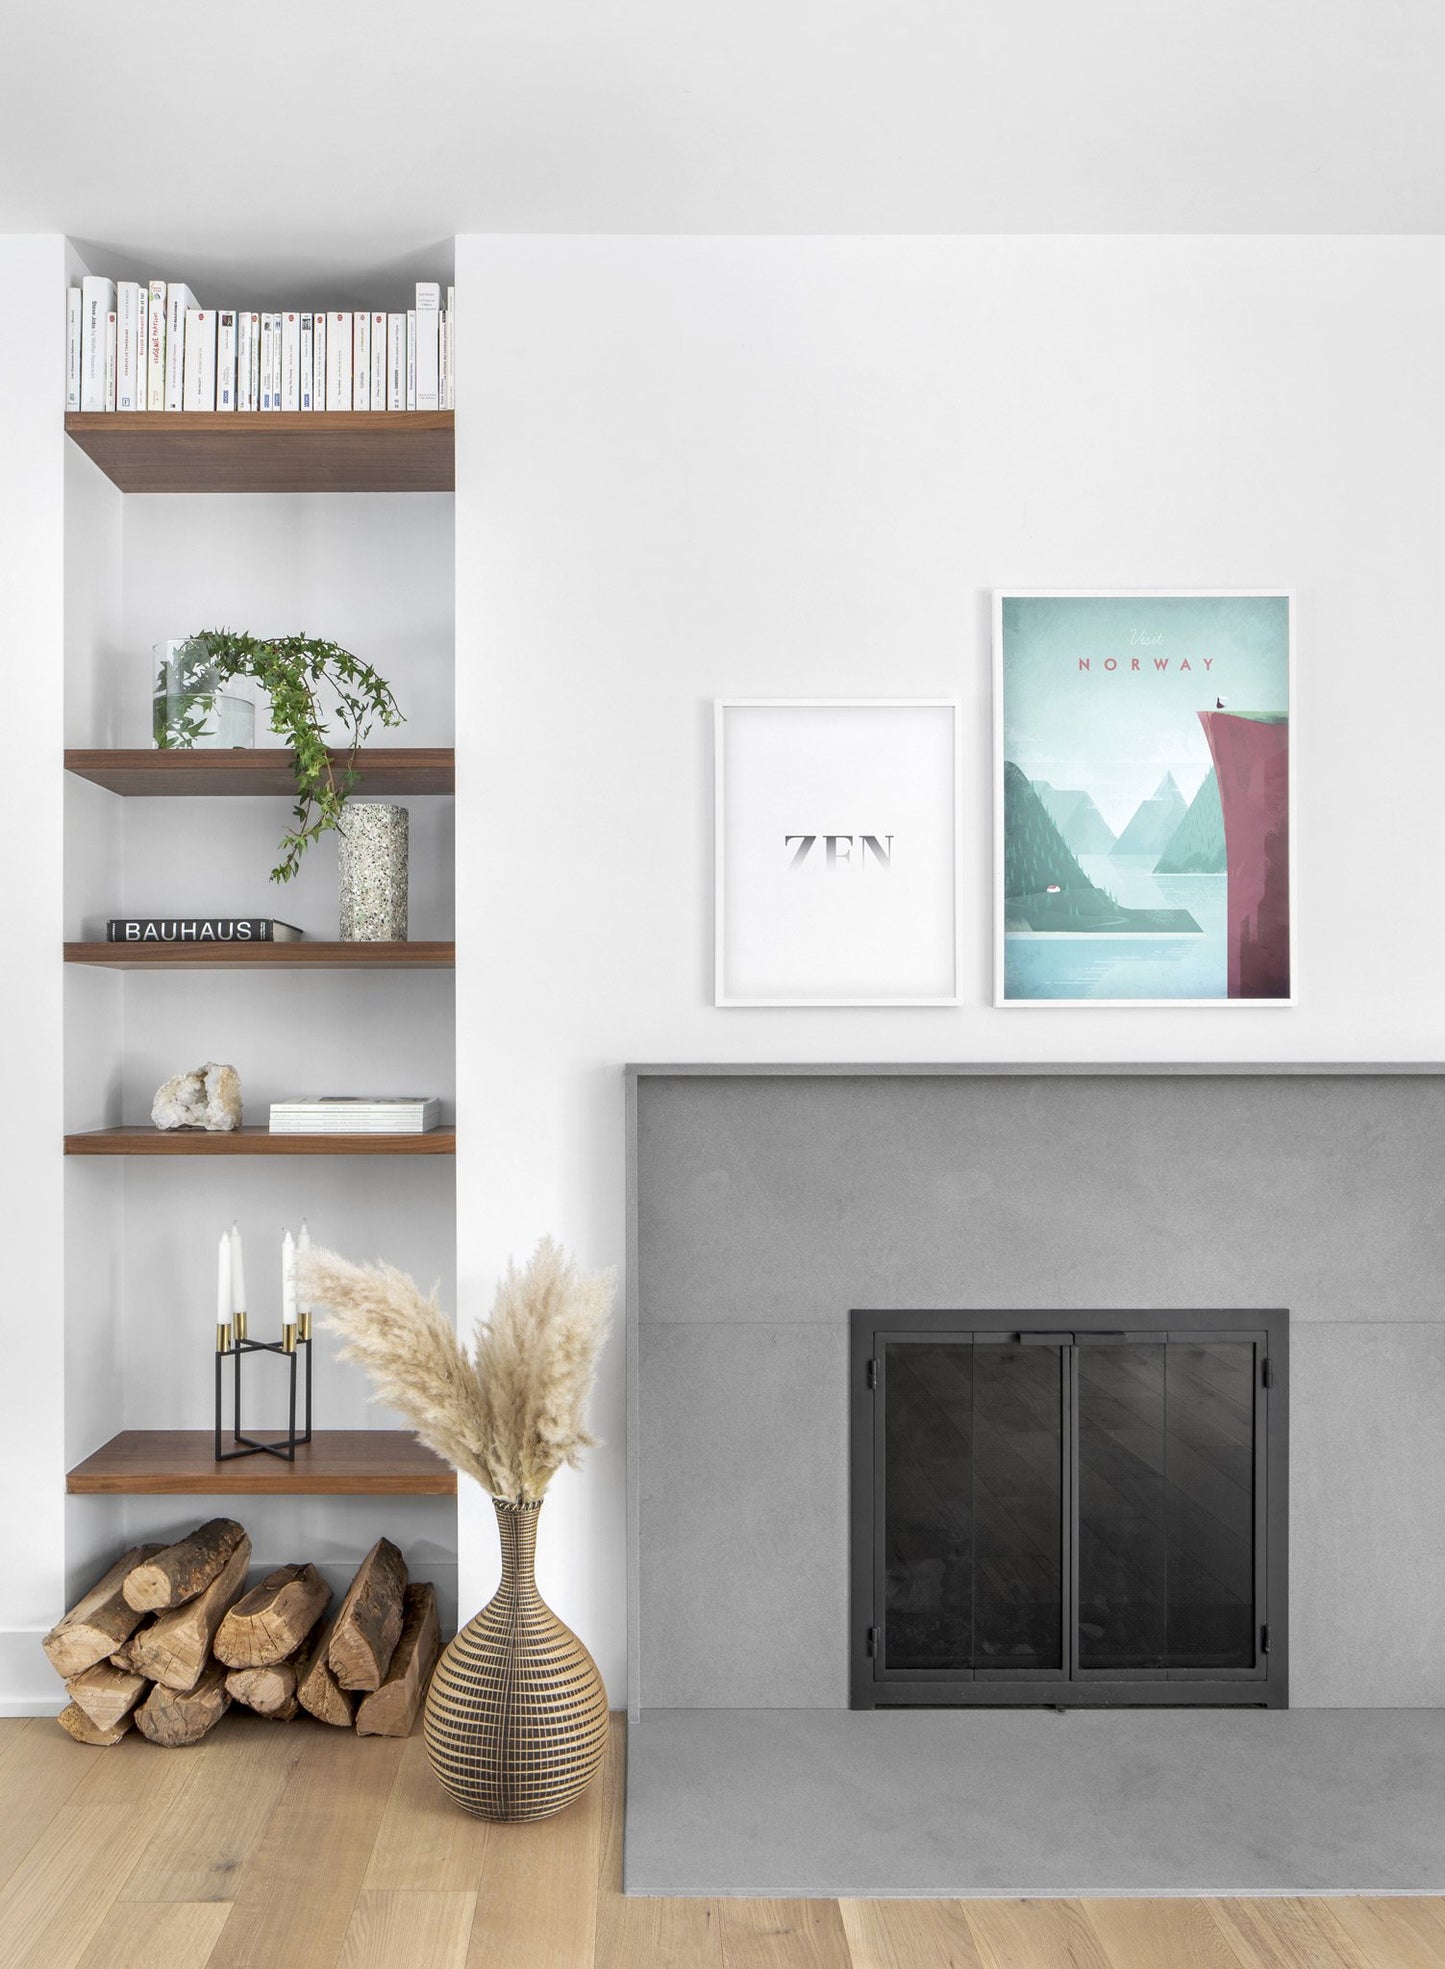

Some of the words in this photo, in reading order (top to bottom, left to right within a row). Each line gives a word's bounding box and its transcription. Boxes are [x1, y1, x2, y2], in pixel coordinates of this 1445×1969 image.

[1129, 627, 1164, 646] Visit
[1078, 657, 1214, 671] NORWAY
[784, 835, 895, 870] ZEN
[125, 921, 252, 941] BAUHAUS
